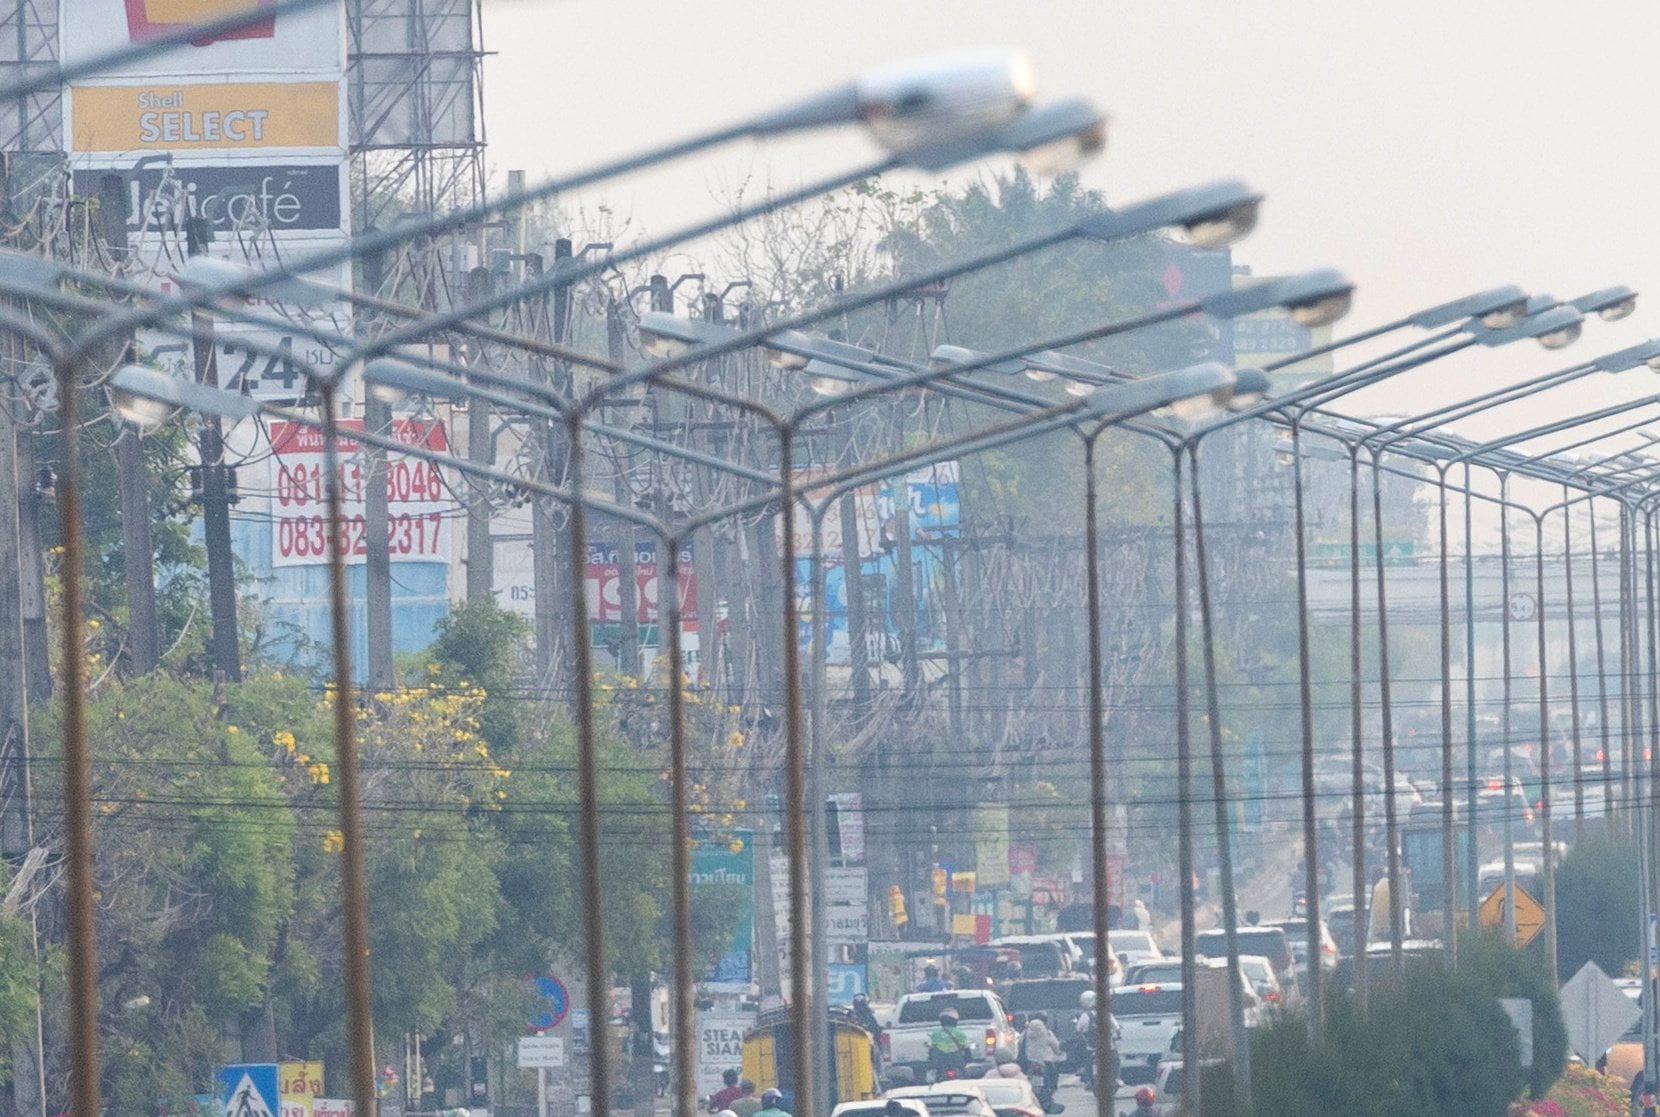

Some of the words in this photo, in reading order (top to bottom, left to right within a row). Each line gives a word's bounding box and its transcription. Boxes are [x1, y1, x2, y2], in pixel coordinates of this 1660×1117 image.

[138, 91, 183, 109] Shell
[139, 110, 269, 142] SELECT
[703, 1029, 745, 1042] STEA
